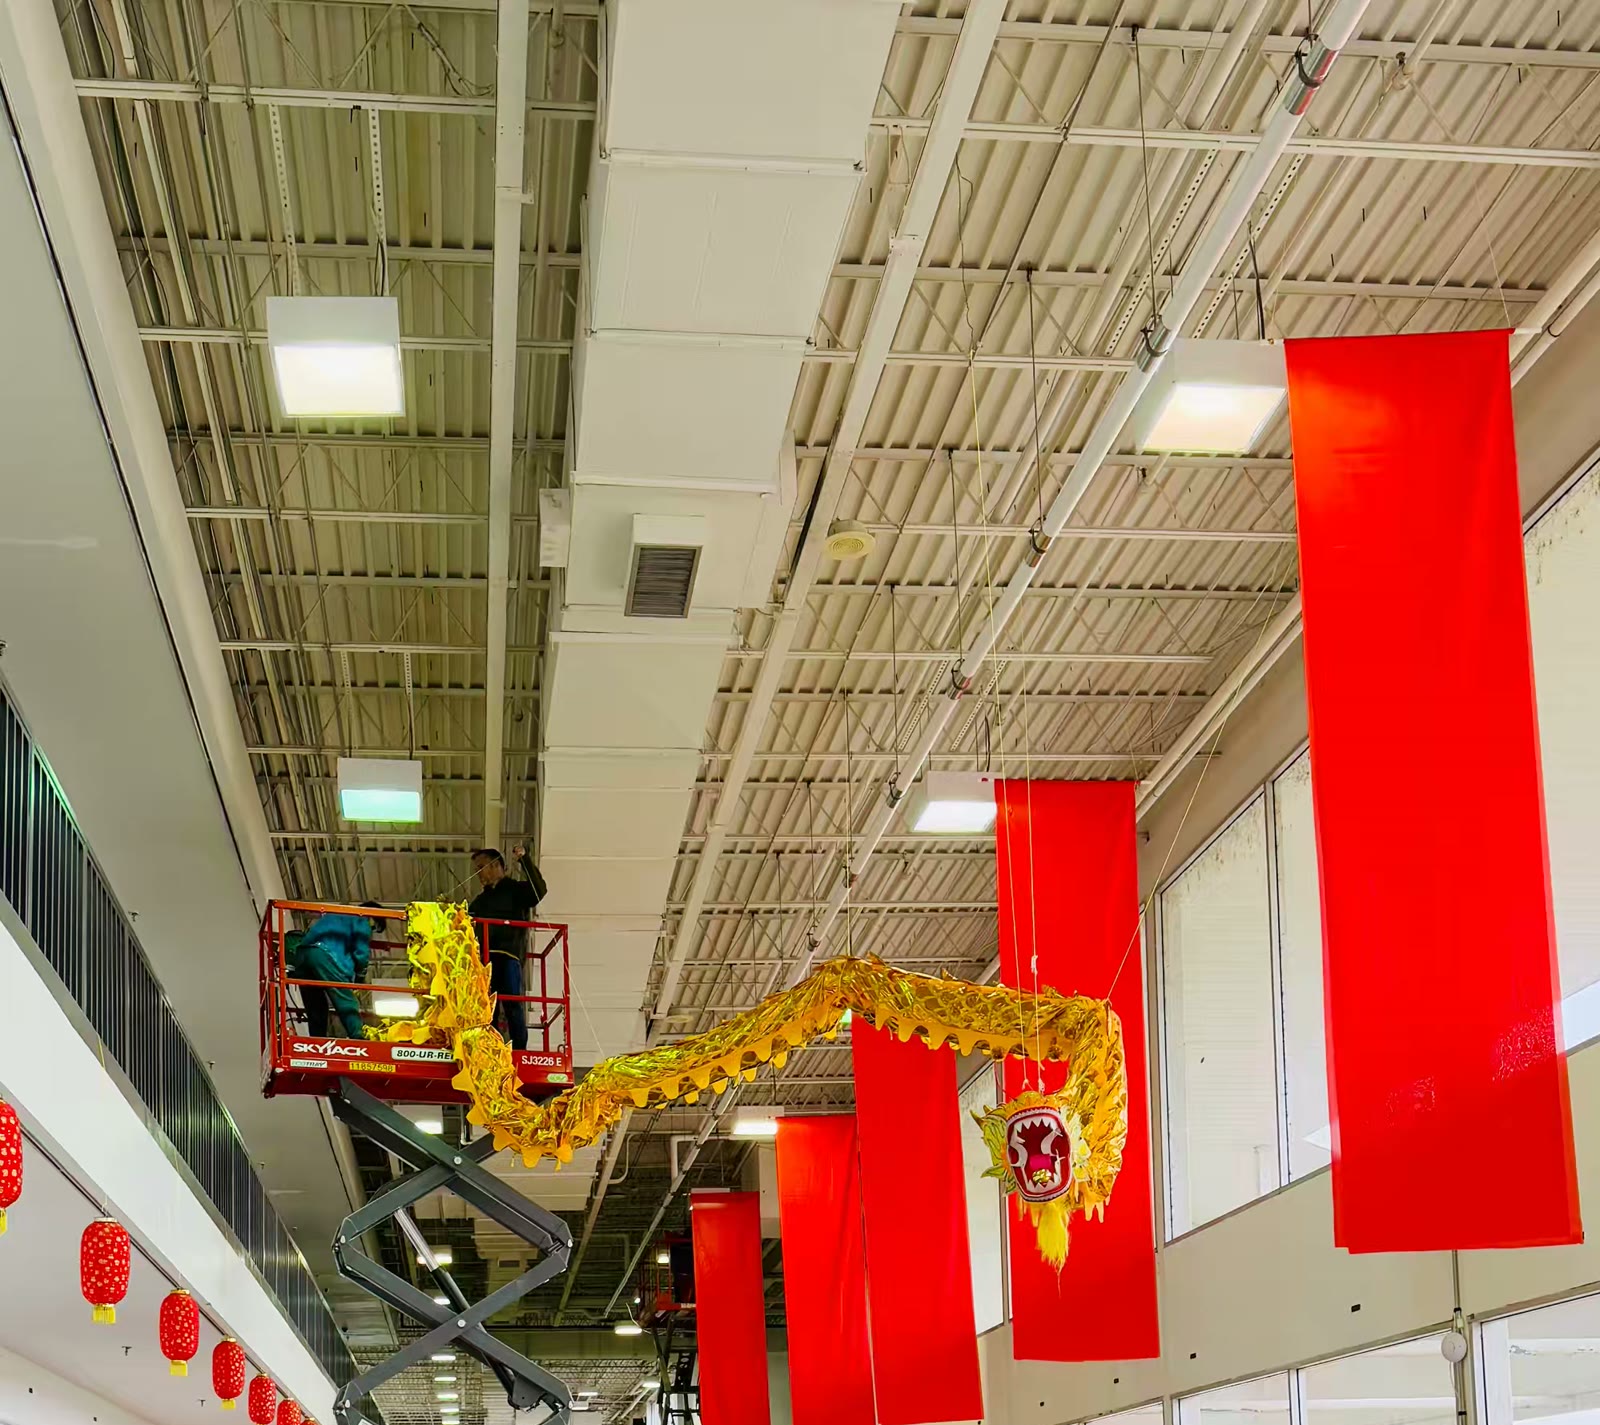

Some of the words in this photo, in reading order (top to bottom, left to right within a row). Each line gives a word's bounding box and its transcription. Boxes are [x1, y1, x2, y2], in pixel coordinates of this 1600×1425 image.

[293, 1040, 369, 1057] SKYJACK
[521, 1055, 554, 1066] SJ3226
[556, 1057, 562, 1067] E
